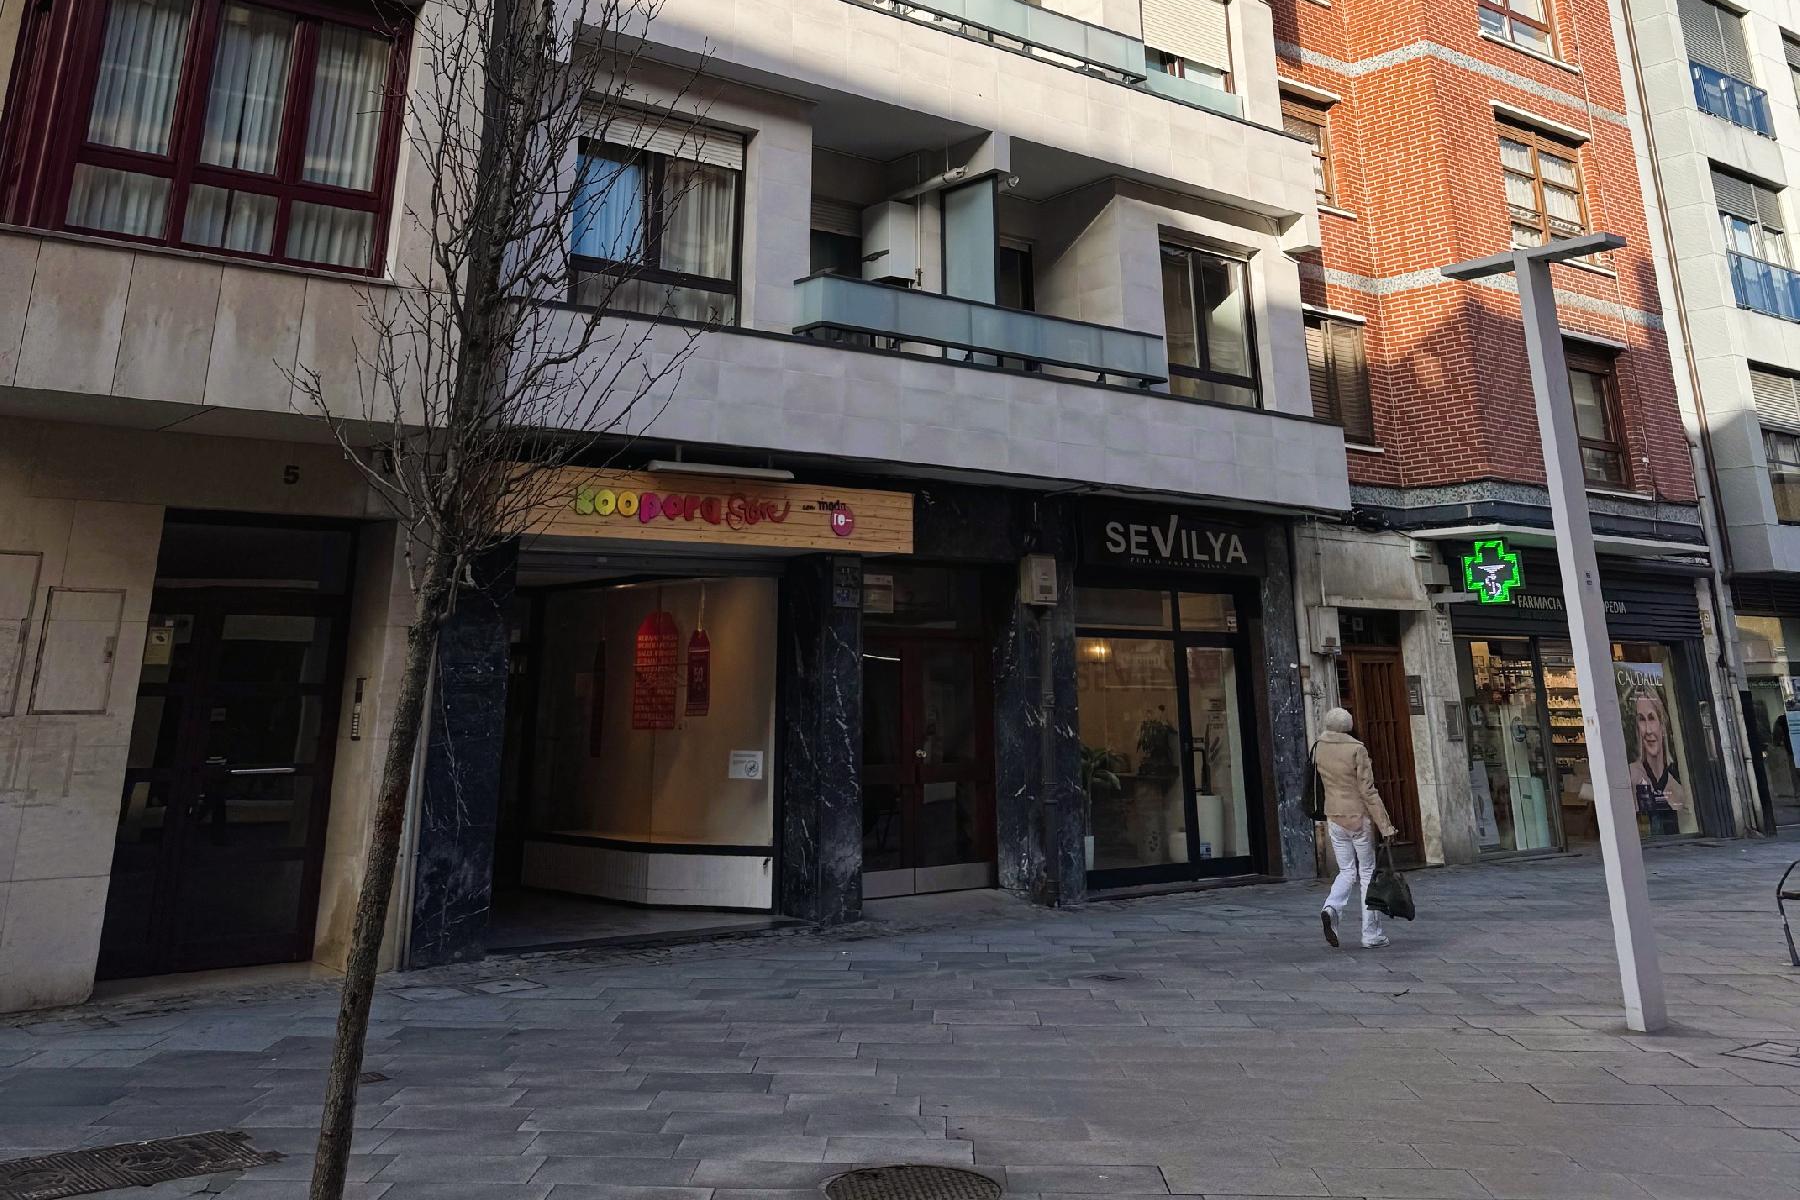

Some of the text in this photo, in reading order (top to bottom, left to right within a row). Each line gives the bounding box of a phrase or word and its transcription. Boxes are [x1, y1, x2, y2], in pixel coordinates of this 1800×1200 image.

[284, 465, 299, 484] 5
[1105, 514, 1248, 563] SEVILYA
[1517, 594, 1627, 615] FARMACIA PEDIA
